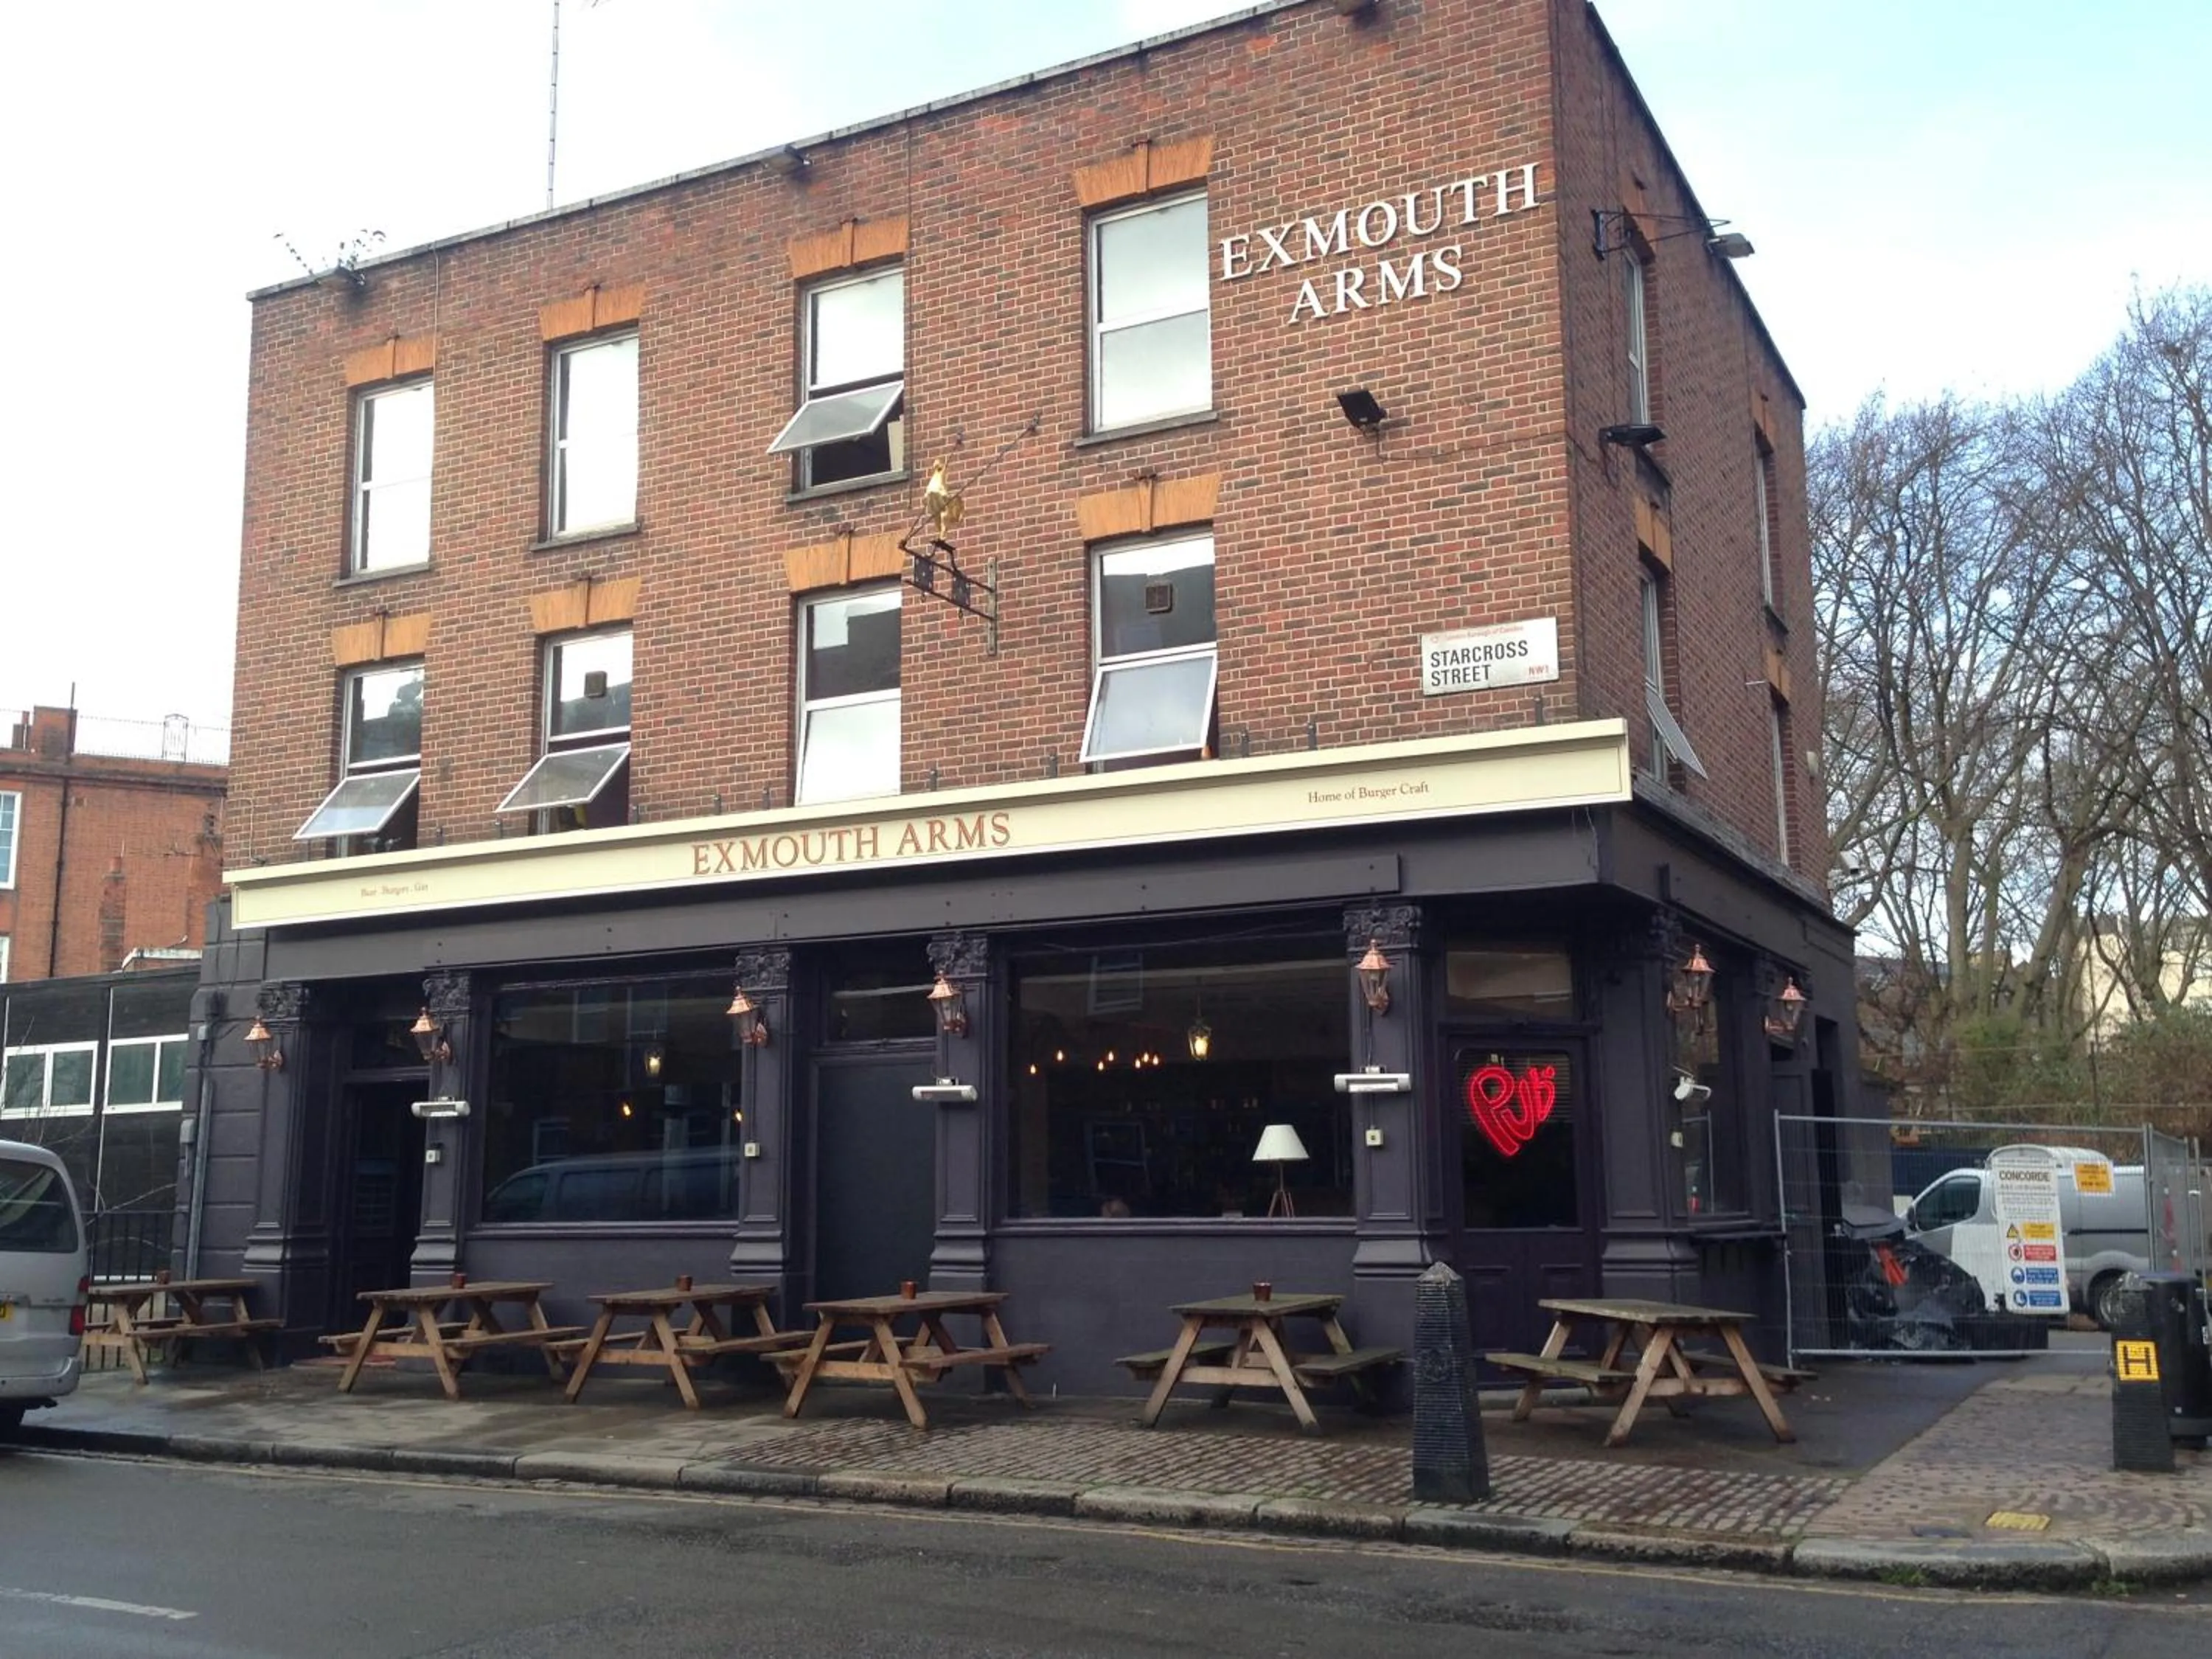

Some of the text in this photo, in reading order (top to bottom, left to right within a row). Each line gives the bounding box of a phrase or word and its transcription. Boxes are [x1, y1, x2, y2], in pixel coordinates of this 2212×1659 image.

[1218, 162, 1541, 282] EXMOUTH
[1287, 244, 1464, 325] ARMS
[1430, 639, 1528, 668] STARCROSS
[1430, 664, 1549, 686] STREET NW1
[1307, 781, 1430, 804] Home of Burger Craft
[692, 812, 1011, 875] EXMOUTH ARMS
[1999, 1170, 2051, 1182] CONCORDE
[2123, 1345, 2152, 1375] H
